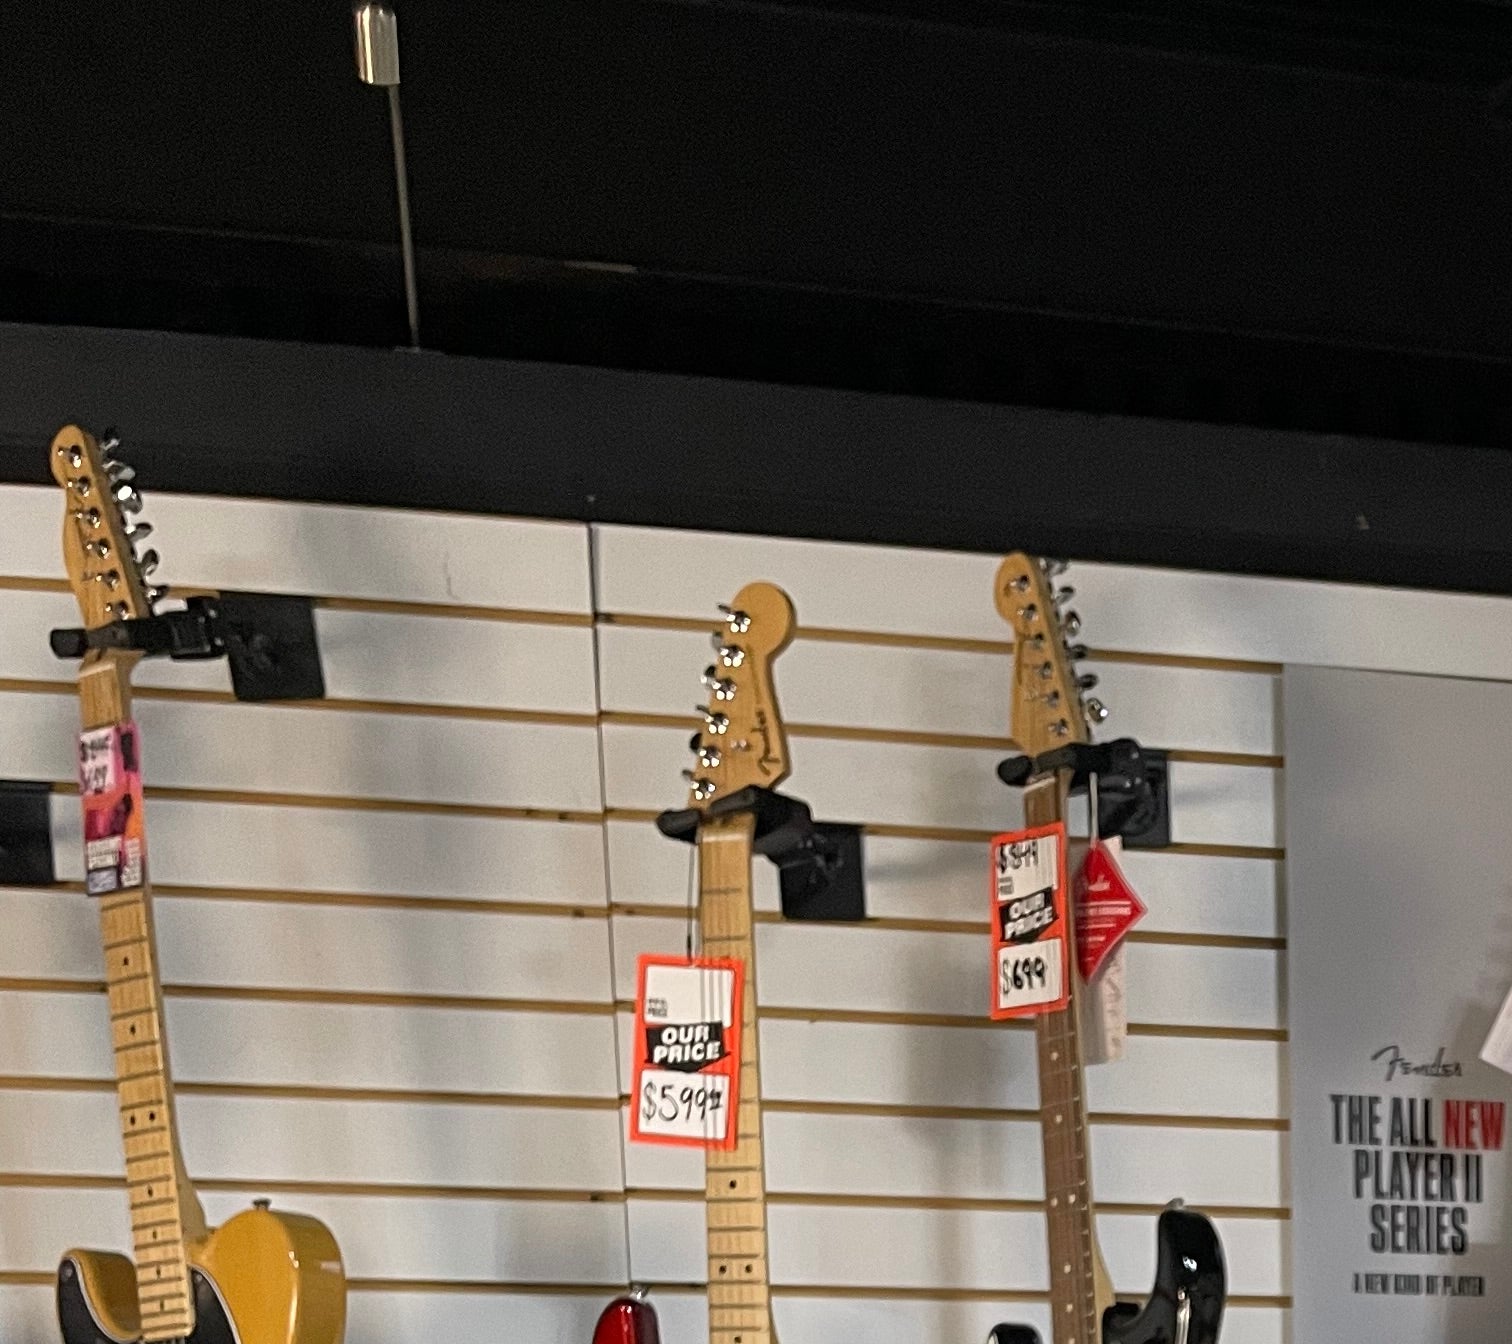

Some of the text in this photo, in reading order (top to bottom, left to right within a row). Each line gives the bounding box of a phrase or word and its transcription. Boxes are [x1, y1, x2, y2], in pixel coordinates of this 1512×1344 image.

[1004, 906, 1054, 940] PRICE
[1009, 892, 1046, 921] OUR
[1002, 956, 1047, 995] $699
[652, 1040, 722, 1064] PRICE
[660, 1025, 710, 1046] OUR
[1371, 1045, 1463, 1081] Fender
[1330, 1094, 1505, 1151] THE ALL NEW
[1354, 1149, 1483, 1203] PLAYER II
[1370, 1203, 1470, 1255] SERIES
